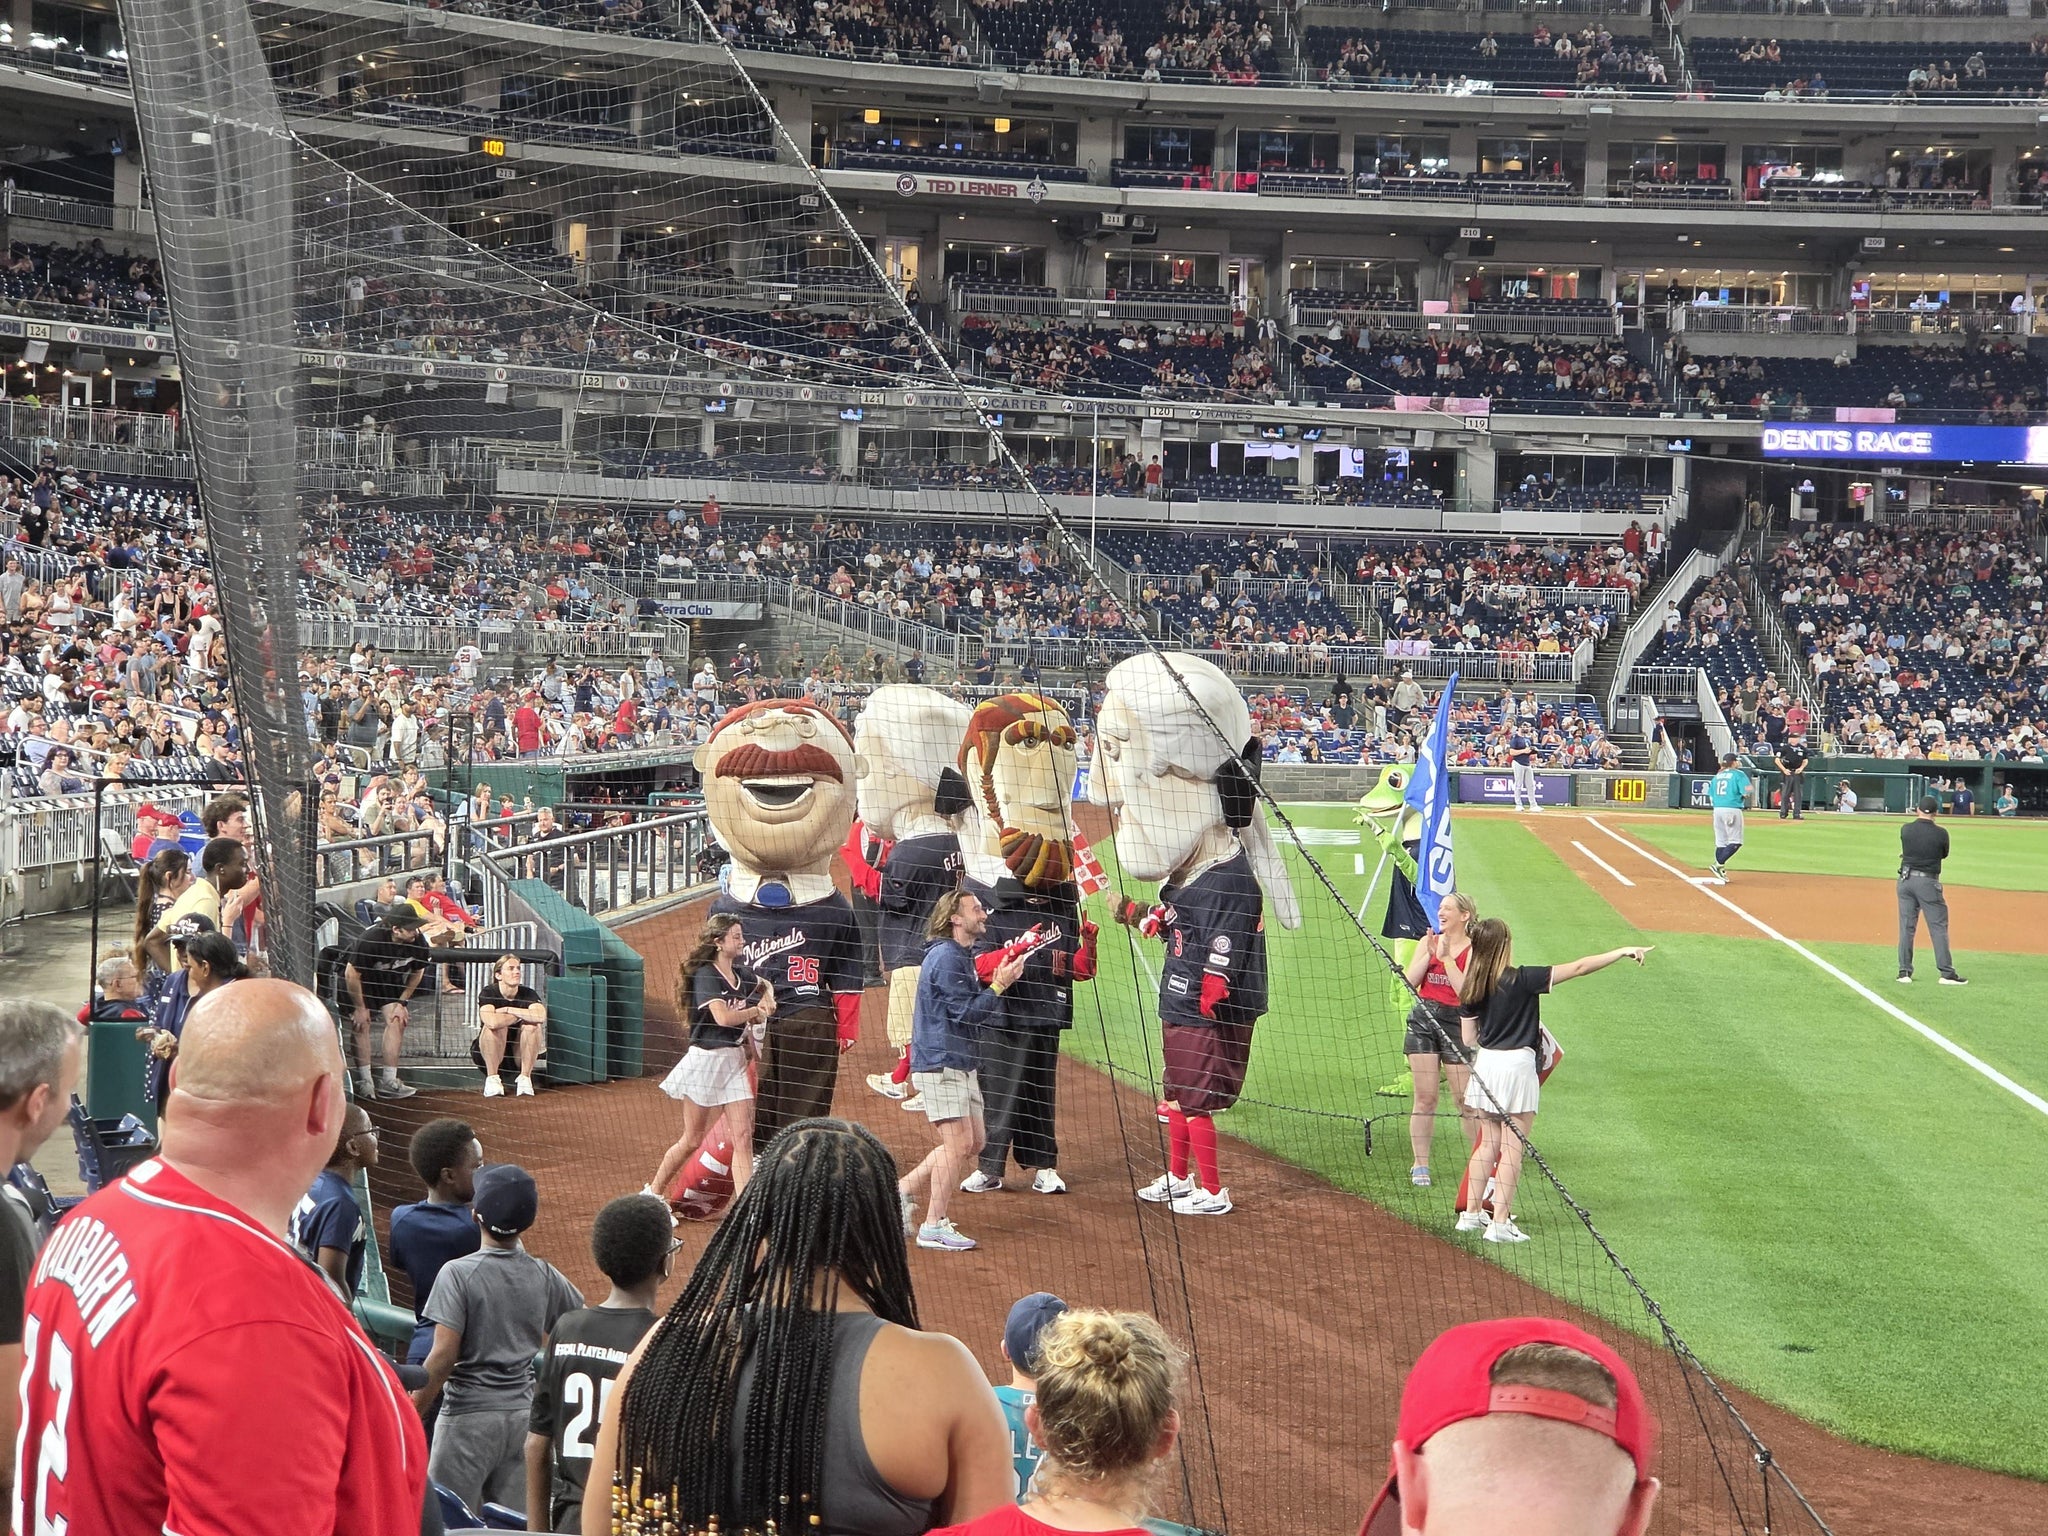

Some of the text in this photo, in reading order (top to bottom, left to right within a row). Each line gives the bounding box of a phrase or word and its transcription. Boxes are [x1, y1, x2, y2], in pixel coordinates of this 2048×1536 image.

[926, 180, 956, 193] TED
[960, 181, 1018, 197] LERNER
[29, 325, 47, 337] 124
[80, 330, 136, 347] CRONIN
[305, 355, 322, 365] 123
[507, 370, 573, 386] JOHNSON
[583, 377, 600, 387] 122
[630, 380, 712, 393] KILLEBREW
[734, 384, 794, 399] MANUSH
[815, 390, 848, 403] RICE
[919, 395, 961, 407] WYNN
[991, 398, 1047, 412] CARTER
[1075, 402, 1136, 416] DAWSON
[1153, 407, 1170, 416] 120
[1469, 419, 1484, 429] 119
[1761, 429, 1932, 453] DENTS RACE
[687, 605, 713, 616] Club
[1060, 699, 1075, 711] DC
[1614, 779, 1645, 801] 1:00
[1716, 780, 1727, 795] 12
[1691, 795, 1714, 806] ML
[742, 927, 806, 971] Nationals
[787, 955, 820, 984] 26
[34, 1216, 137, 1349] RADBURN
[577, 1342, 608, 1360] PLAYER
